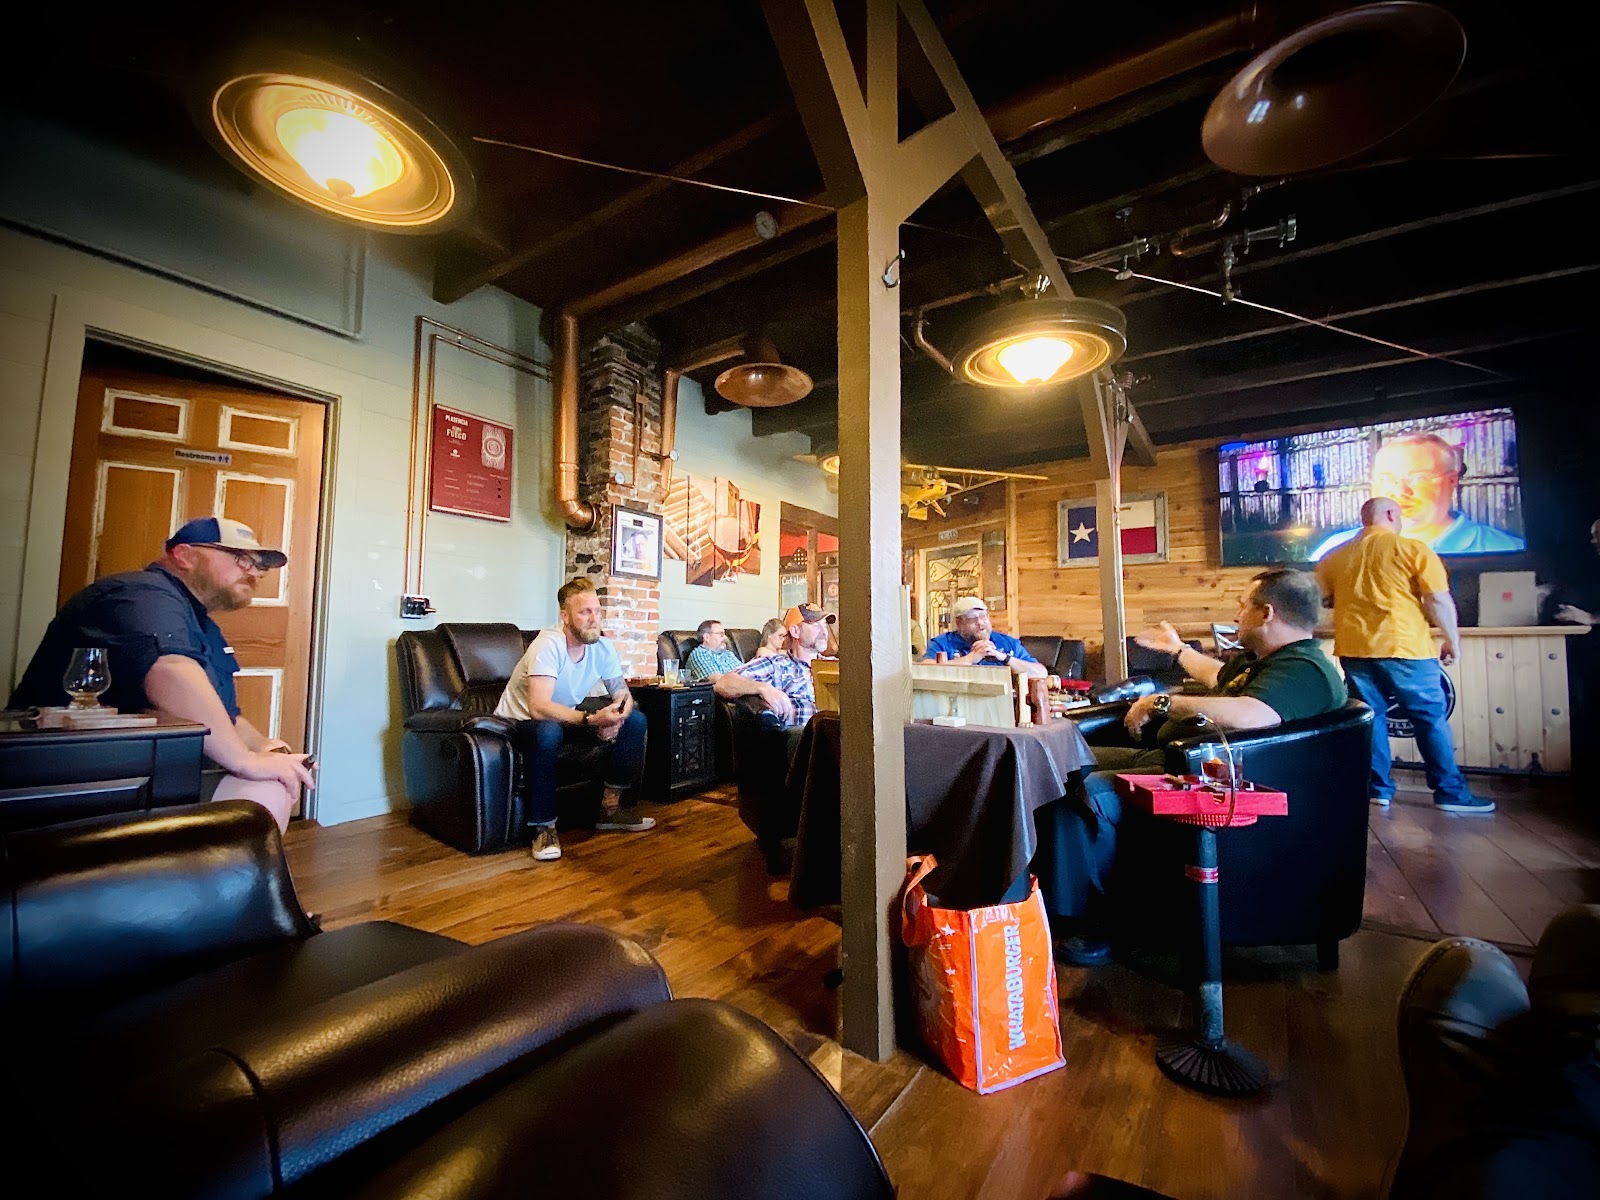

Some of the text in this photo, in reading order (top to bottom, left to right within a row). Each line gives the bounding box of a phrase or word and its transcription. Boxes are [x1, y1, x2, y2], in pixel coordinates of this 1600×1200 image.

[446, 428, 467, 440] FUEGO
[175, 450, 216, 461] Restrooms
[1003, 923, 1027, 1051] WHATABURGER
